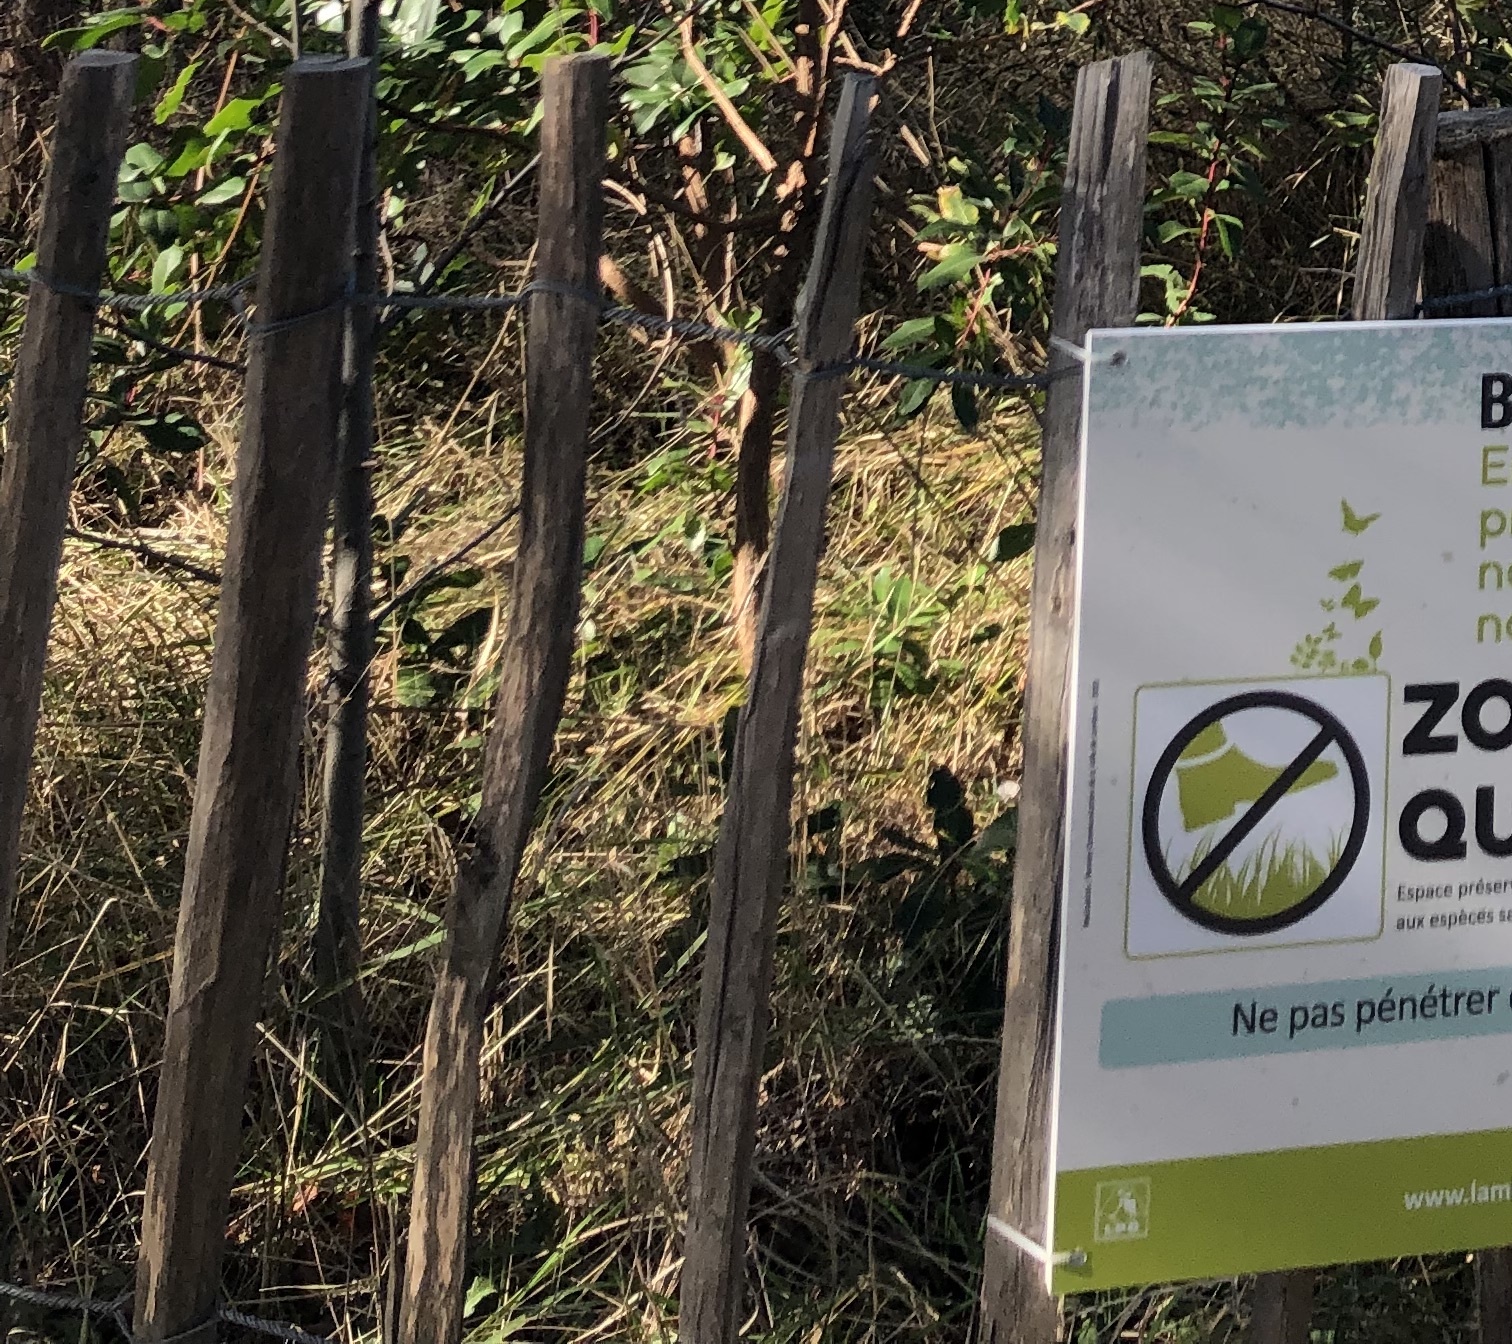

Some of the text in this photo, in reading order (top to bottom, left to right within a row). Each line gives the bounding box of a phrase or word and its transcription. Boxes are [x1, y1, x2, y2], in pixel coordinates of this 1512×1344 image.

[1397, 884, 1453, 903] Espace
[1396, 912, 1425, 931] aux
[1429, 906, 1494, 931] espèces
[1231, 1002, 1278, 1037] Ne
[1288, 997, 1345, 1040] pas
[1355, 983, 1501, 1034] pénétrer
